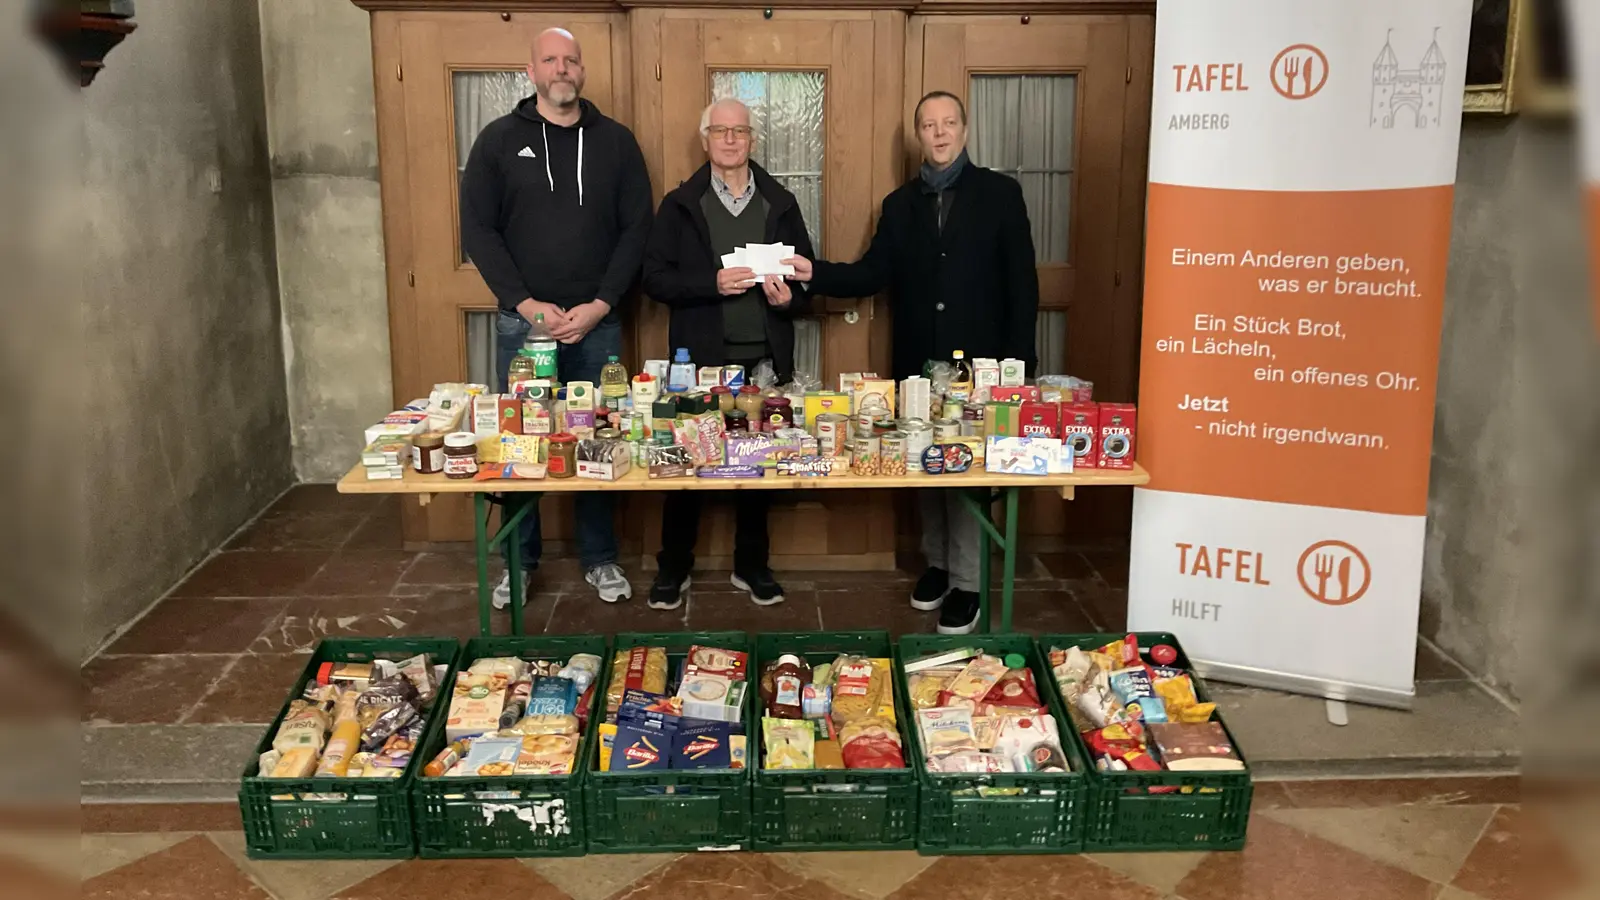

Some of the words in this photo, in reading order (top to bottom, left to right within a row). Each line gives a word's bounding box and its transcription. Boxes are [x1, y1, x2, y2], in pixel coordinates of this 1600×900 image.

[1172, 63, 1249, 93] TAFEL
[1168, 113, 1230, 131] AMBERG
[1171, 248, 1235, 267] Einem
[1240, 250, 1329, 269] Anderen
[1335, 252, 1410, 274] geben,
[1258, 278, 1300, 294] was
[1306, 279, 1329, 294] er
[1334, 277, 1422, 298] braucht.
[1194, 314, 1226, 332] Ein
[1233, 315, 1291, 334] Stück
[1298, 318, 1347, 340] Brot,
[1156, 337, 1185, 353] ein
[1191, 337, 1276, 360] Lächeln,
[1254, 366, 1284, 382] ein
[1291, 367, 1369, 388] offenes
[1376, 371, 1421, 391] Ohr.
[1177, 394, 1229, 412] Jetzt
[1023, 425, 1052, 435] EXTRA
[1065, 425, 1094, 435] EXTRA
[1102, 427, 1131, 436] EXTRA
[1208, 420, 1257, 439] nicht
[1262, 422, 1390, 450] irgendwann.
[735, 438, 773, 456] Milka
[447, 457, 473, 466] nutella
[1175, 542, 1271, 586] TAFEL
[1172, 598, 1222, 623] HILFT
[626, 748, 657, 760] Barilla
[687, 743, 716, 752] Barilla
